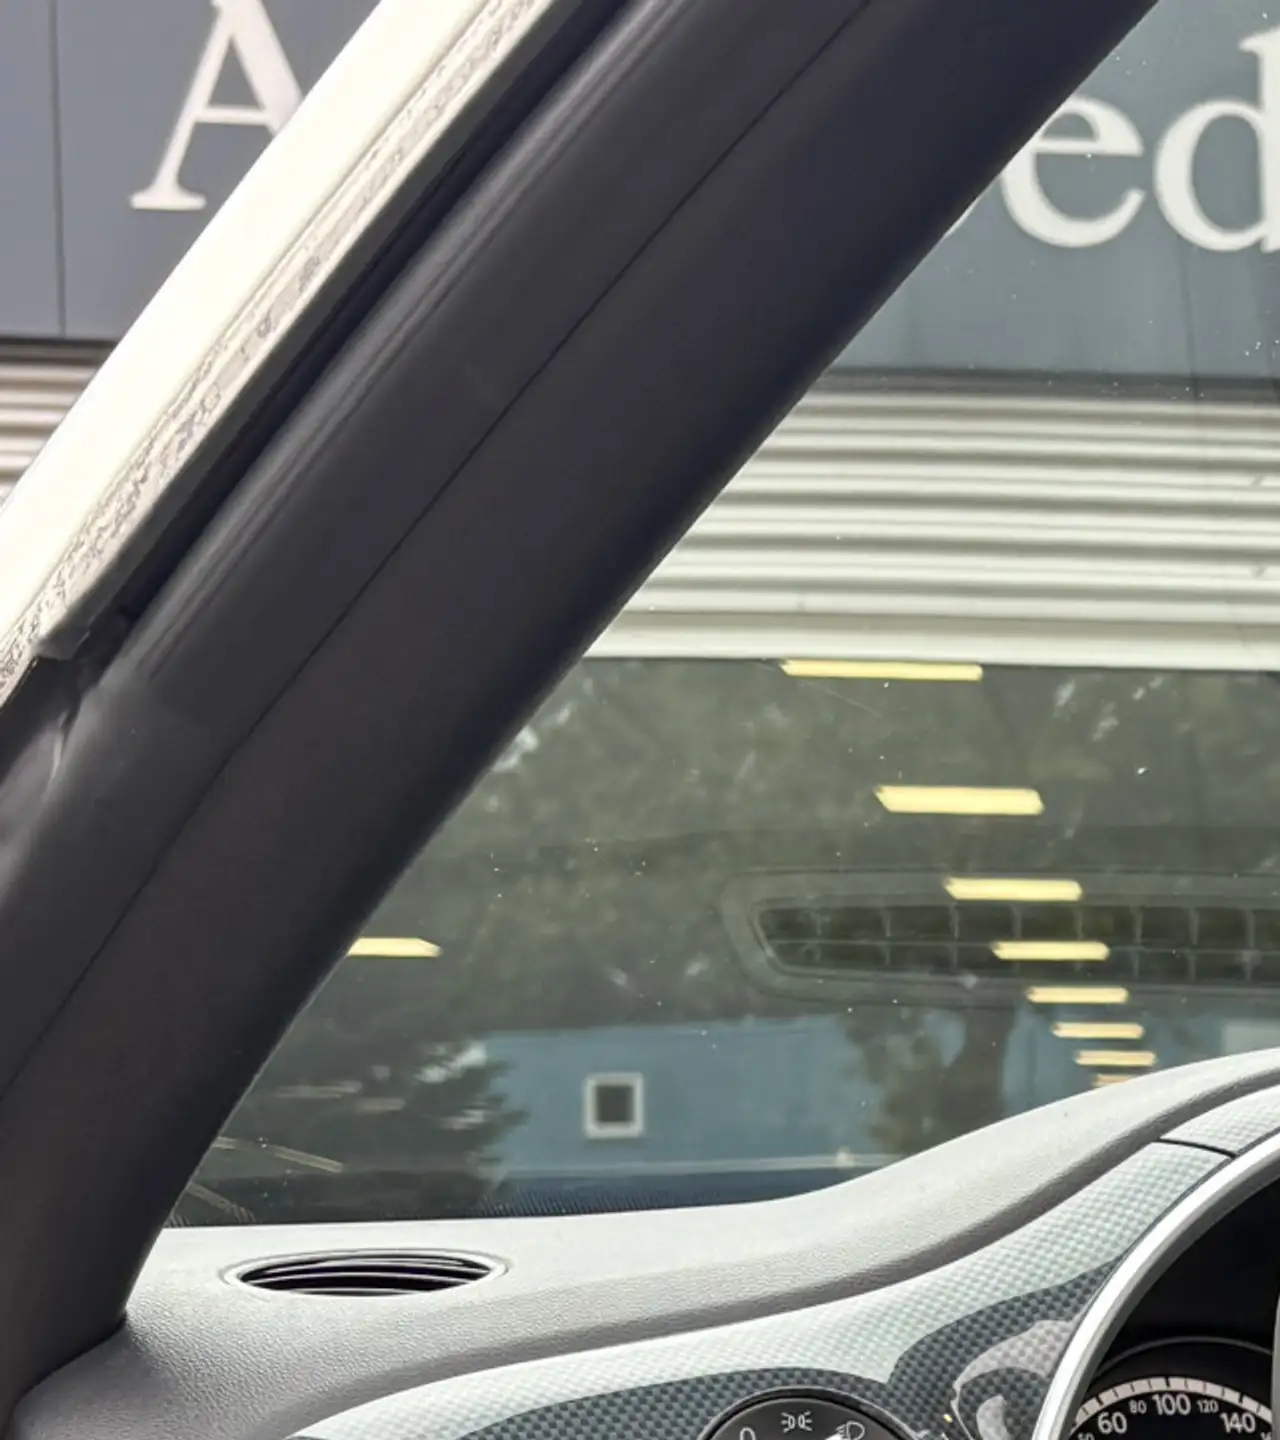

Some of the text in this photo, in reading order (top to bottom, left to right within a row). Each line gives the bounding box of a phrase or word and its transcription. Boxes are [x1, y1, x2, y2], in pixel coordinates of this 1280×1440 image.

[1129, 1401, 1147, 1414] 80
[1152, 1394, 1192, 1415] 100
[1197, 1400, 1219, 1413] 120
[1097, 1412, 1128, 1434] 60
[1220, 1412, 1256, 1433] 140
